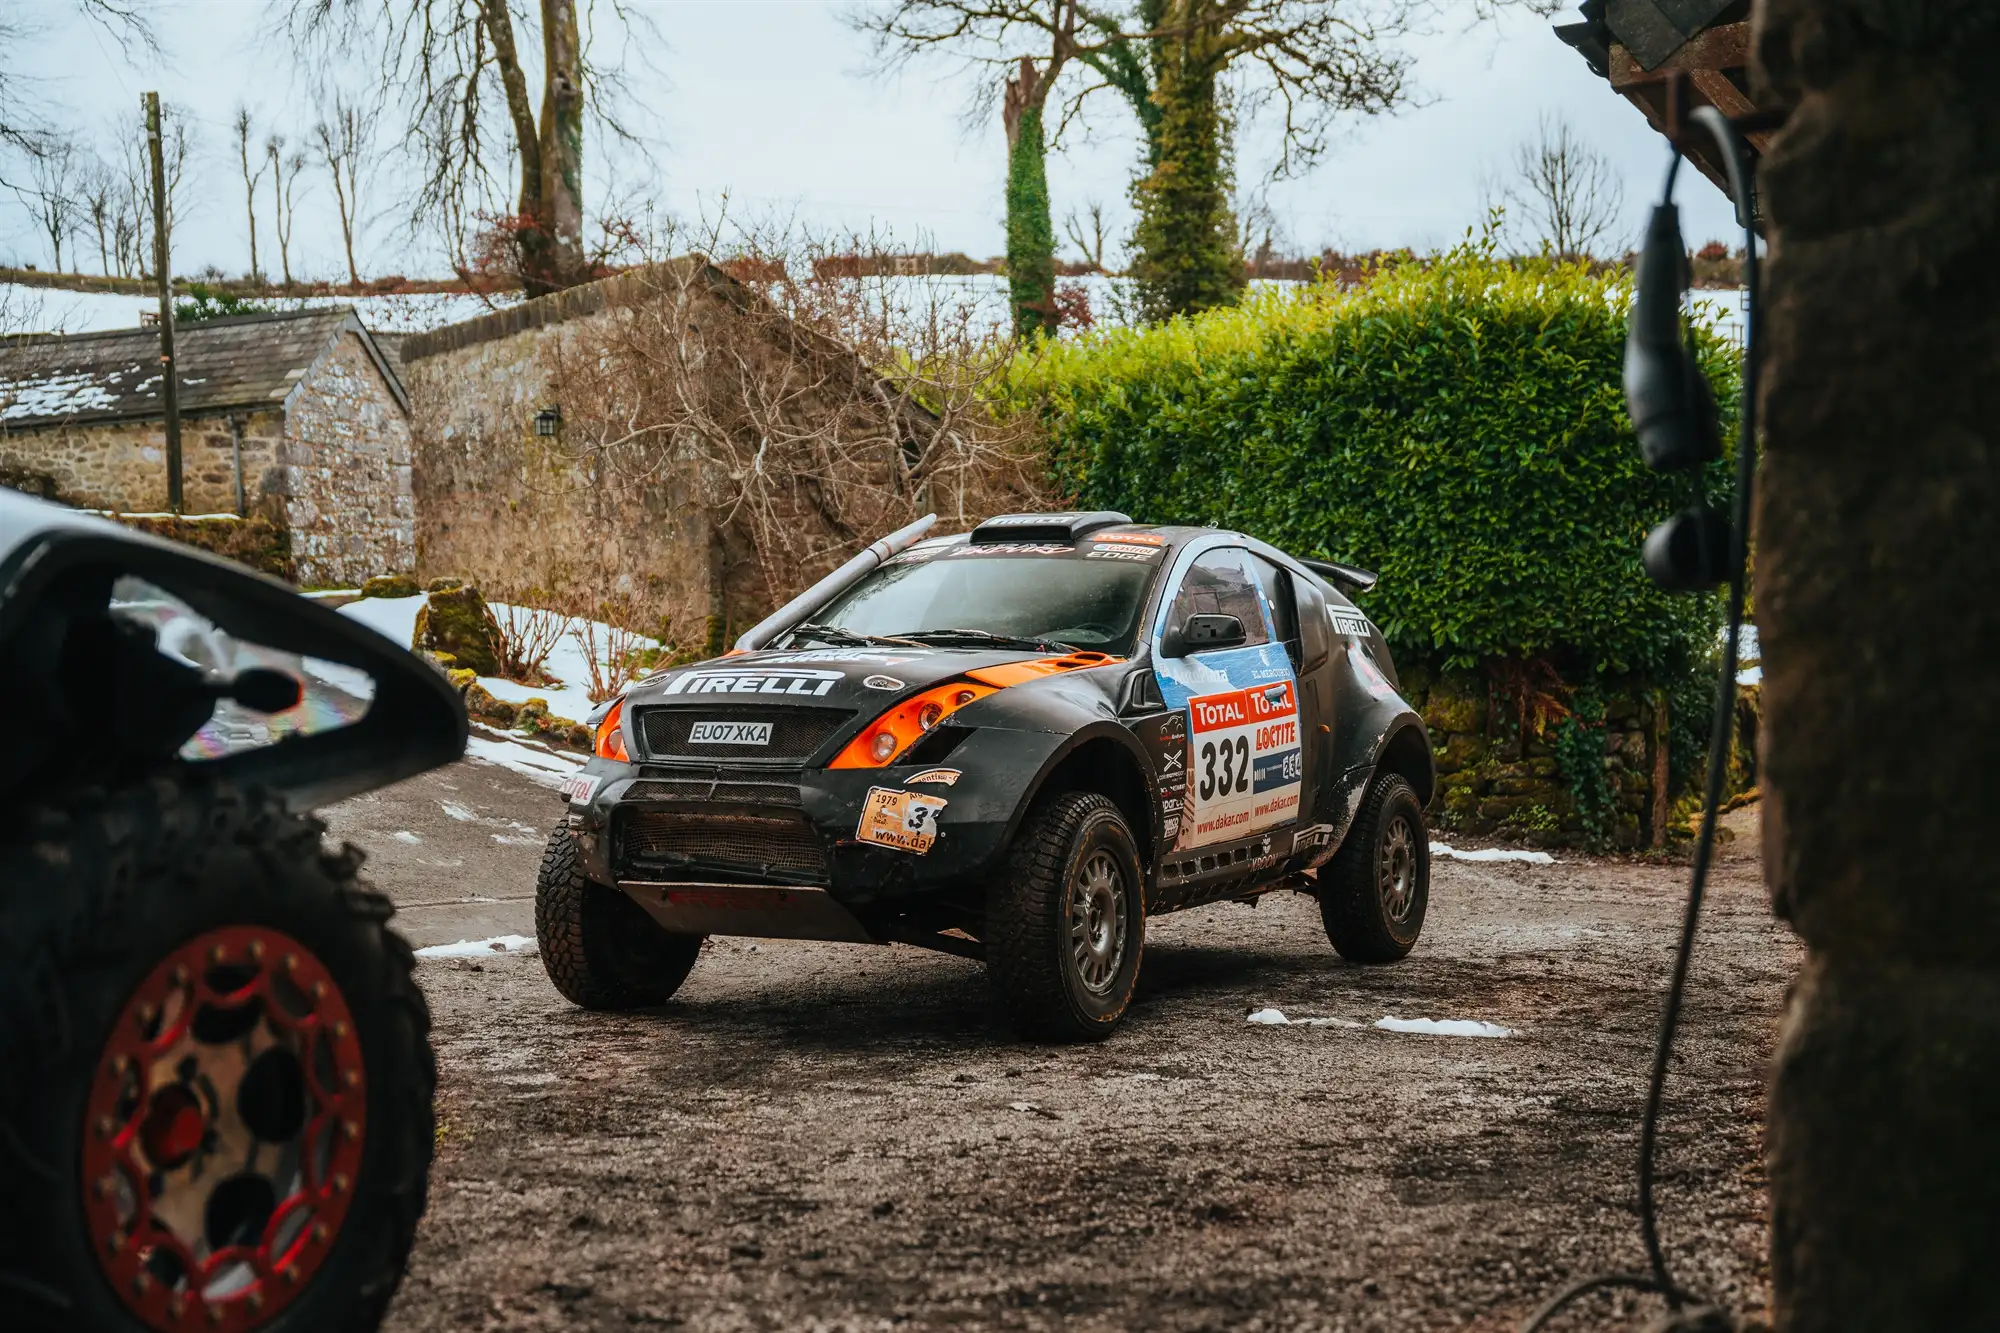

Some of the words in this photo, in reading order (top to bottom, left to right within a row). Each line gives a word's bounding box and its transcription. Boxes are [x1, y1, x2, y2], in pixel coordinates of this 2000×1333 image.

[1099, 533, 1161, 543] TOTAL
[1107, 544, 1155, 555] Castrol
[1086, 551, 1152, 561] EDGE
[1326, 604, 1371, 637] PIRELLI
[663, 668, 845, 695] PIRELLI
[1196, 702, 1244, 726] TOTAL
[692, 725, 730, 740] EU07
[731, 725, 768, 742] XKA
[1255, 721, 1296, 751] LOCTITE
[1200, 735, 1249, 801] 332
[875, 794, 898, 806] 1979
[1254, 794, 1299, 817] www.dakar.com
[1197, 811, 1250, 834] www.dakar.com
